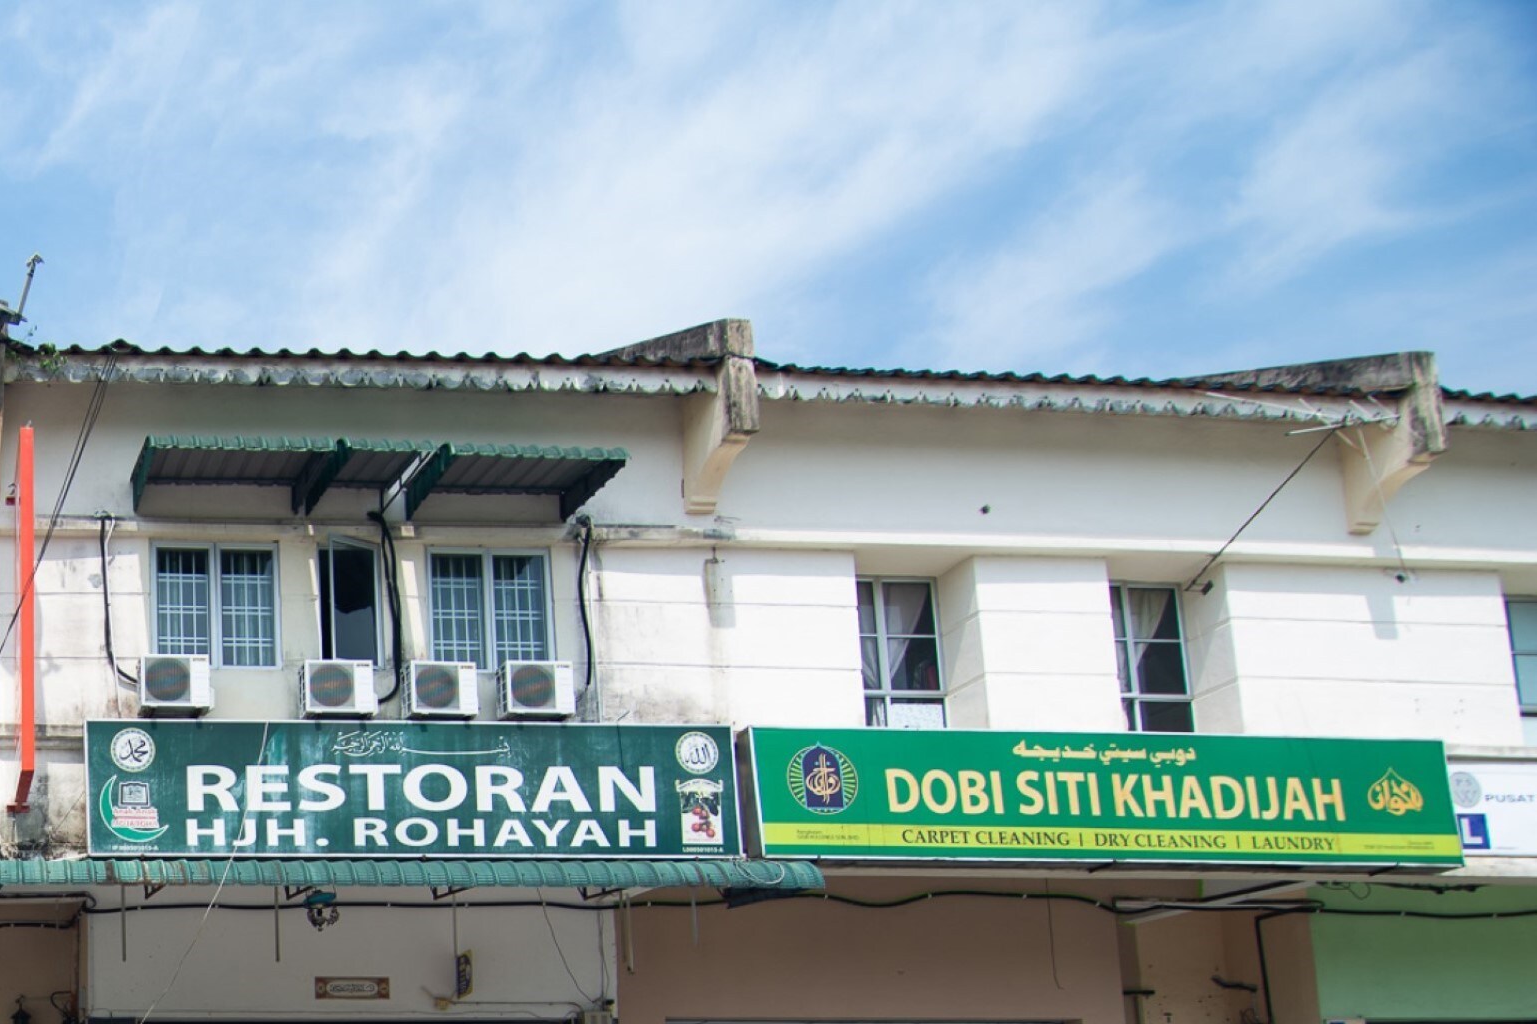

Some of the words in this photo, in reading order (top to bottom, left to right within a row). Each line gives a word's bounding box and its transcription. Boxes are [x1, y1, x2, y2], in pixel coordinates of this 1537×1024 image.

[185, 763, 657, 814] RESTORAN
[885, 768, 1005, 815] DOBI
[1016, 770, 1101, 816] SITI
[1111, 772, 1346, 822] KHADIJAH
[1485, 794, 1535, 803] PUSAT
[186, 818, 329, 848] HJH.
[354, 817, 657, 848] ROHAYAH
[901, 829, 971, 845] CARPET
[975, 831, 1070, 846] CLEANING
[1094, 833, 1130, 847] DRY
[1134, 834, 1227, 848] CLEANING
[1252, 835, 1335, 850] LAUNDRY
[1460, 817, 1483, 844] L
